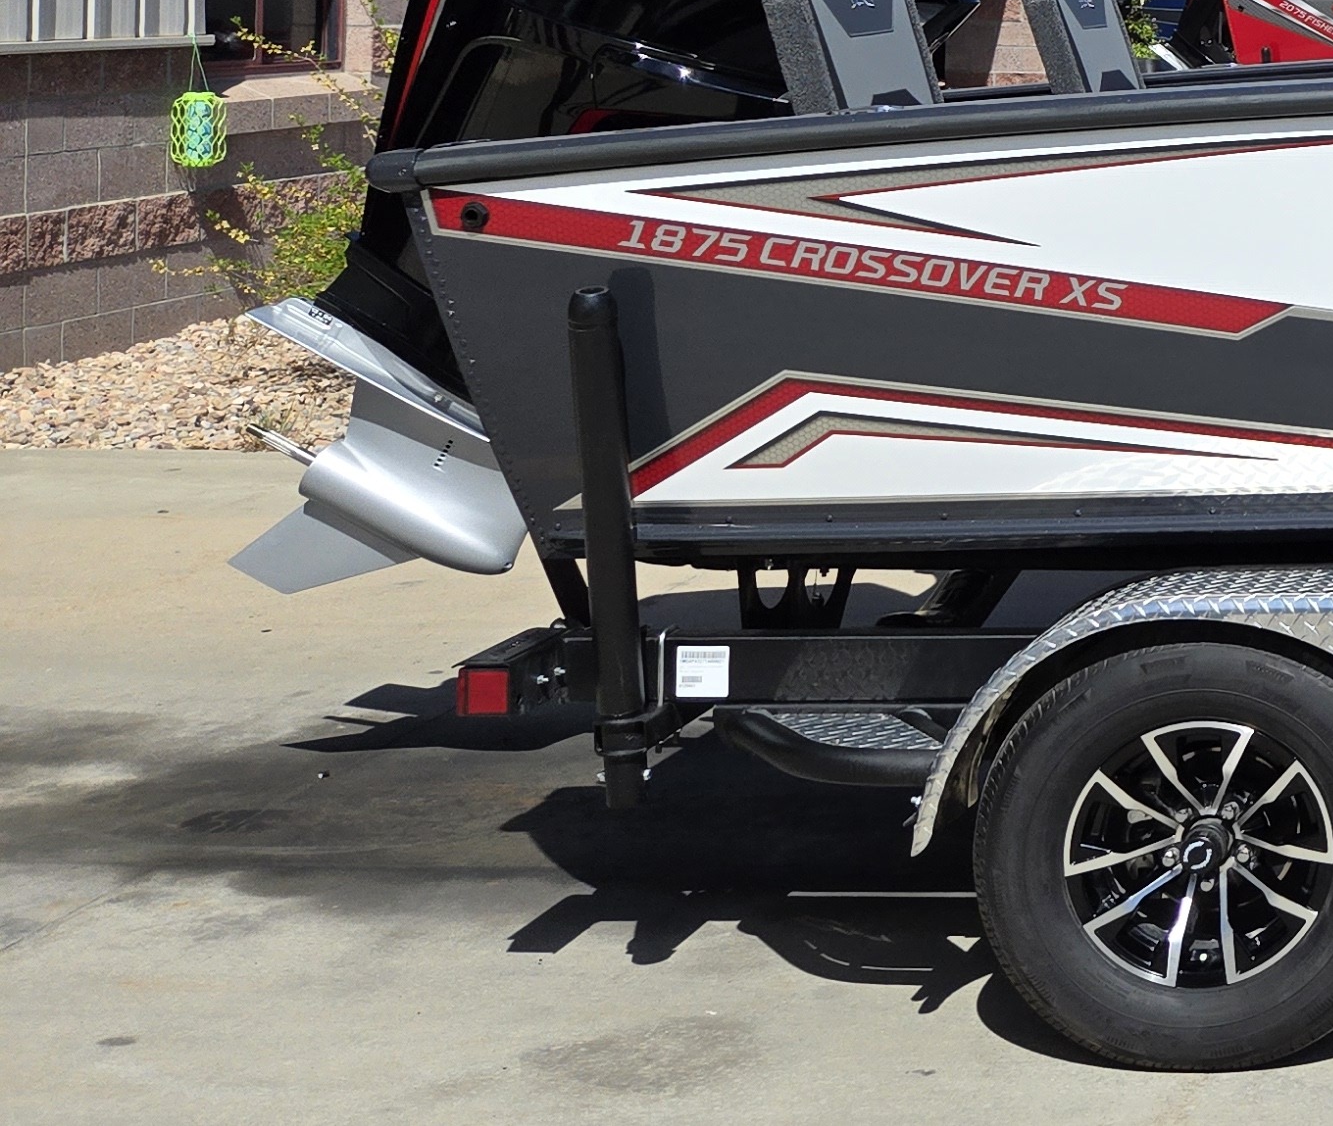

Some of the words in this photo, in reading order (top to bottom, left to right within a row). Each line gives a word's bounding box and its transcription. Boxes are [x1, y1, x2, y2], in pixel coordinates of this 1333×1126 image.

[1279, 0, 1307, 19] 2075
[617, 219, 753, 263] 1875
[759, 236, 1050, 301] CROSSOVER
[1059, 276, 1130, 311] XS
